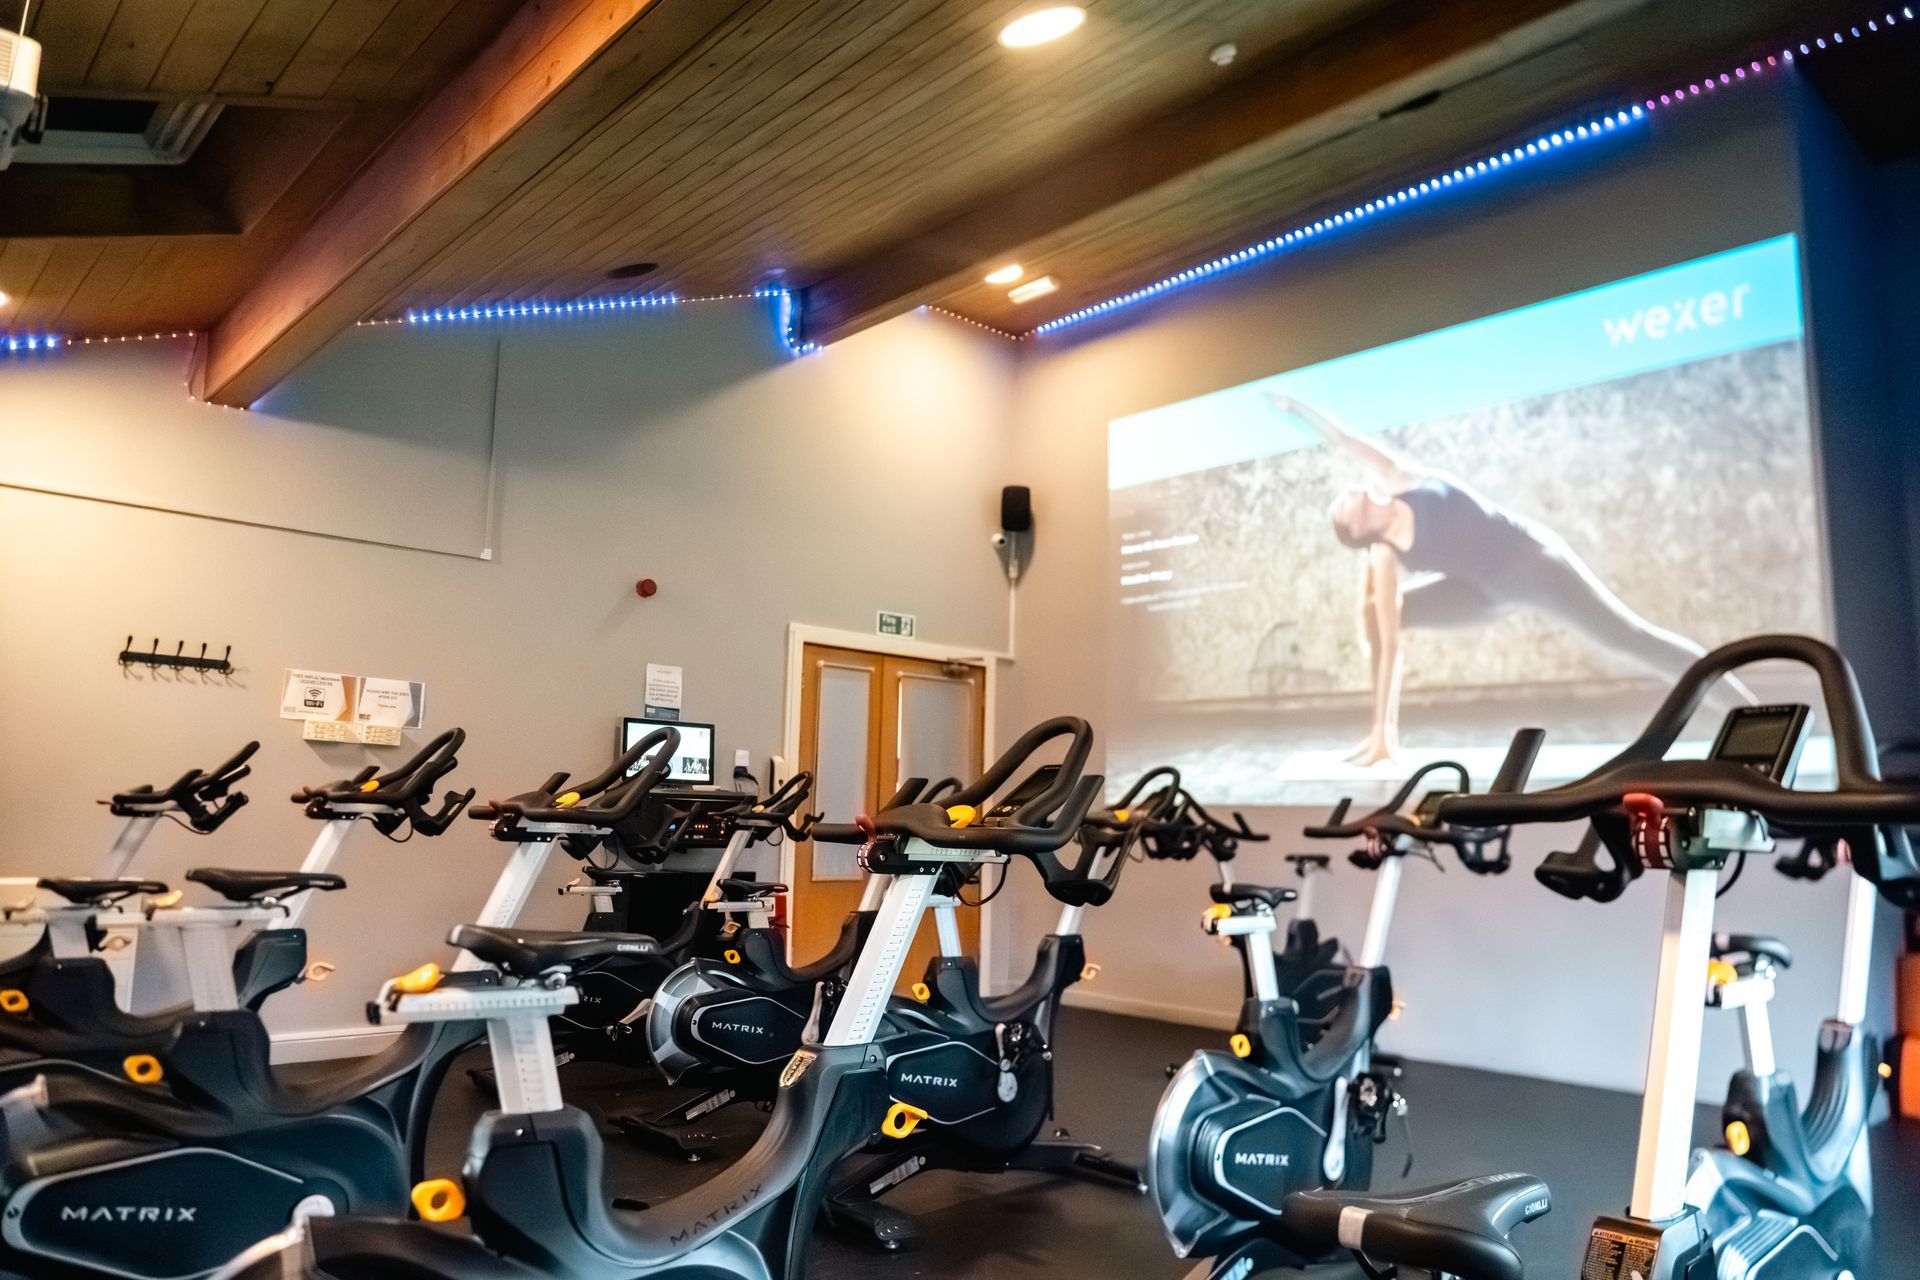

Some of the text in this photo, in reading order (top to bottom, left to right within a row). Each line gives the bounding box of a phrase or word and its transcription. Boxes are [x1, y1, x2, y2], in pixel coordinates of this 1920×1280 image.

[1603, 283, 1752, 346] wexer
[711, 1021, 764, 1034] MATRIX
[900, 1072, 958, 1087] MATRIX
[1235, 1152, 1289, 1167] MATRIX
[61, 1206, 197, 1222] MATRIX
[669, 1183, 761, 1247] MATRIX
